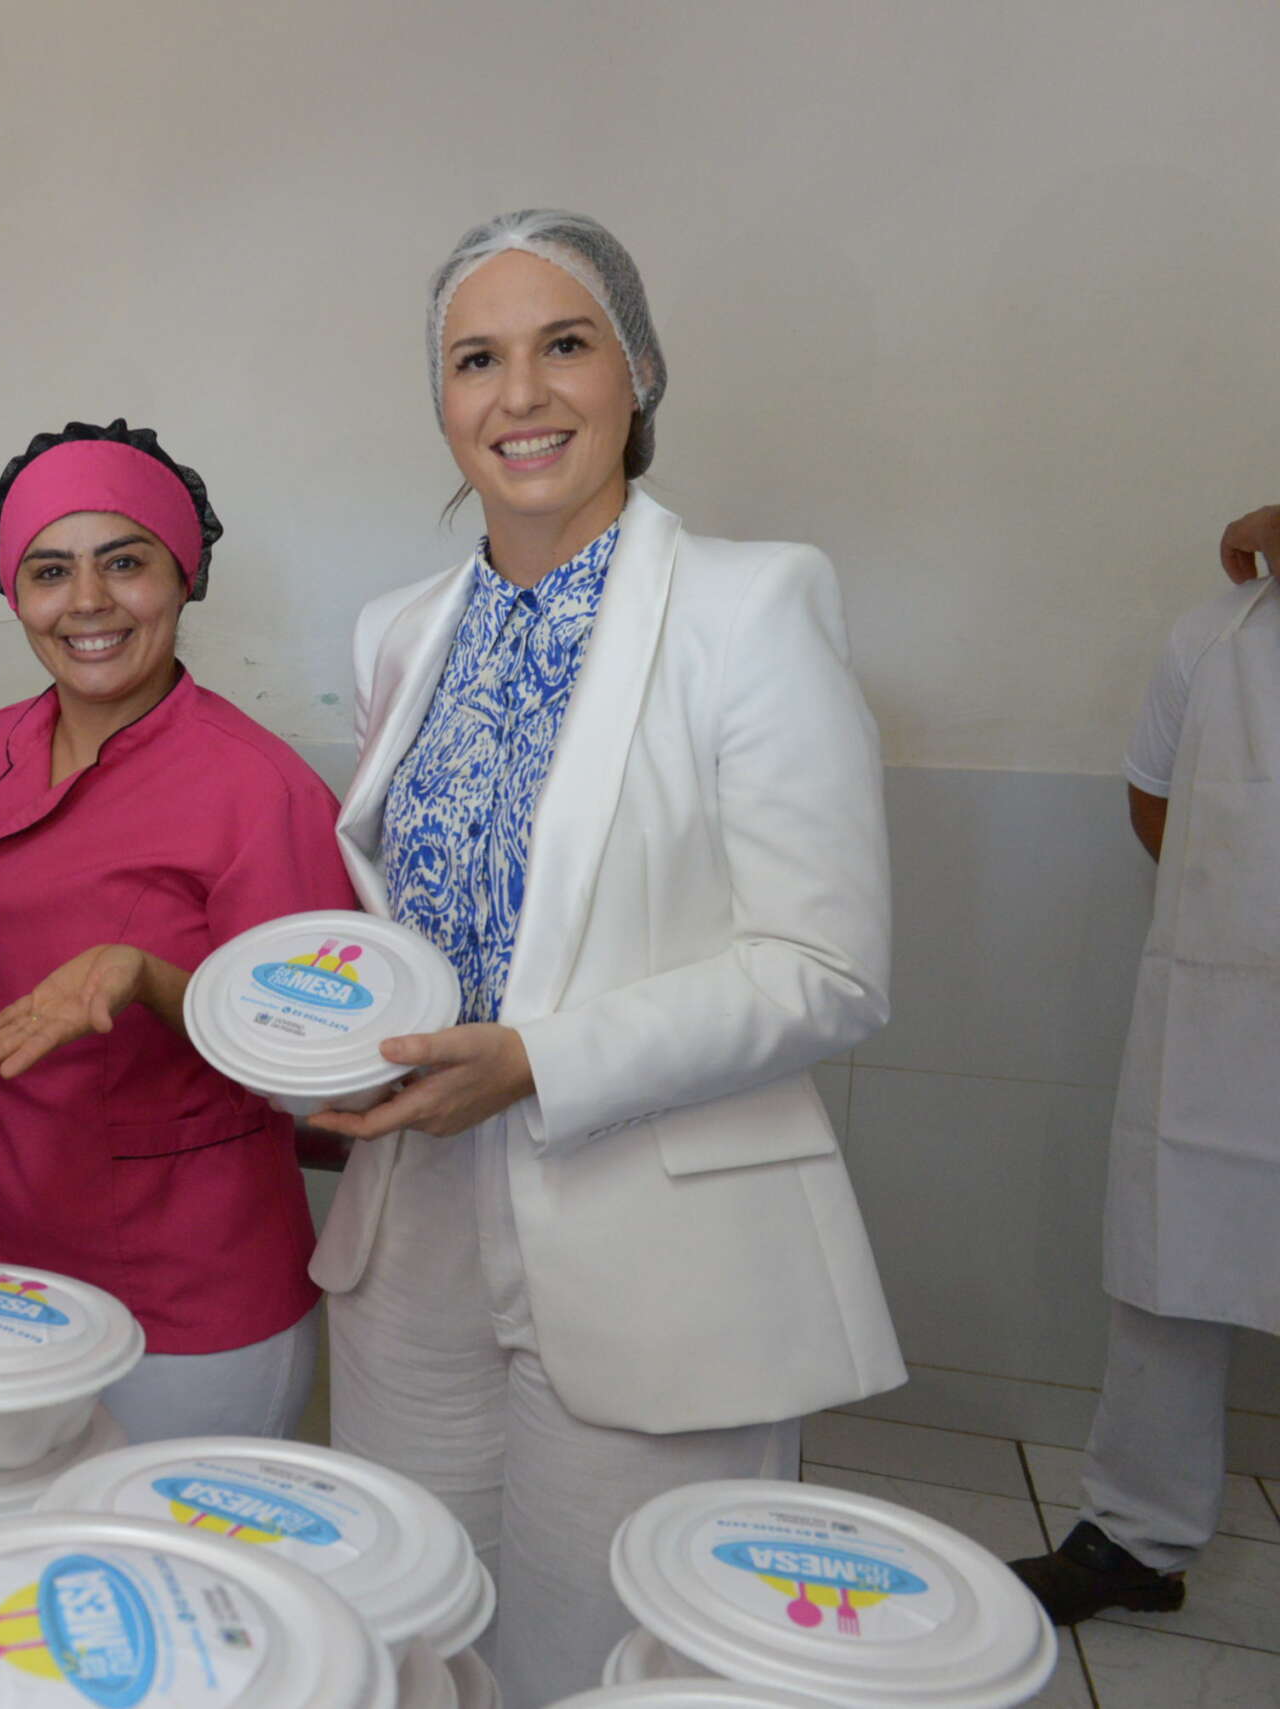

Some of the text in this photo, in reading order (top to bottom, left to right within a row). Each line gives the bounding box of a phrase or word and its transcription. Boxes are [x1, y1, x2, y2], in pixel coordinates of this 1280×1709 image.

[287, 970, 353, 1004] MESA
[179, 1482, 284, 1524] MESA
[747, 1548, 857, 1582] MESA
[52, 1569, 132, 1651] MESA
